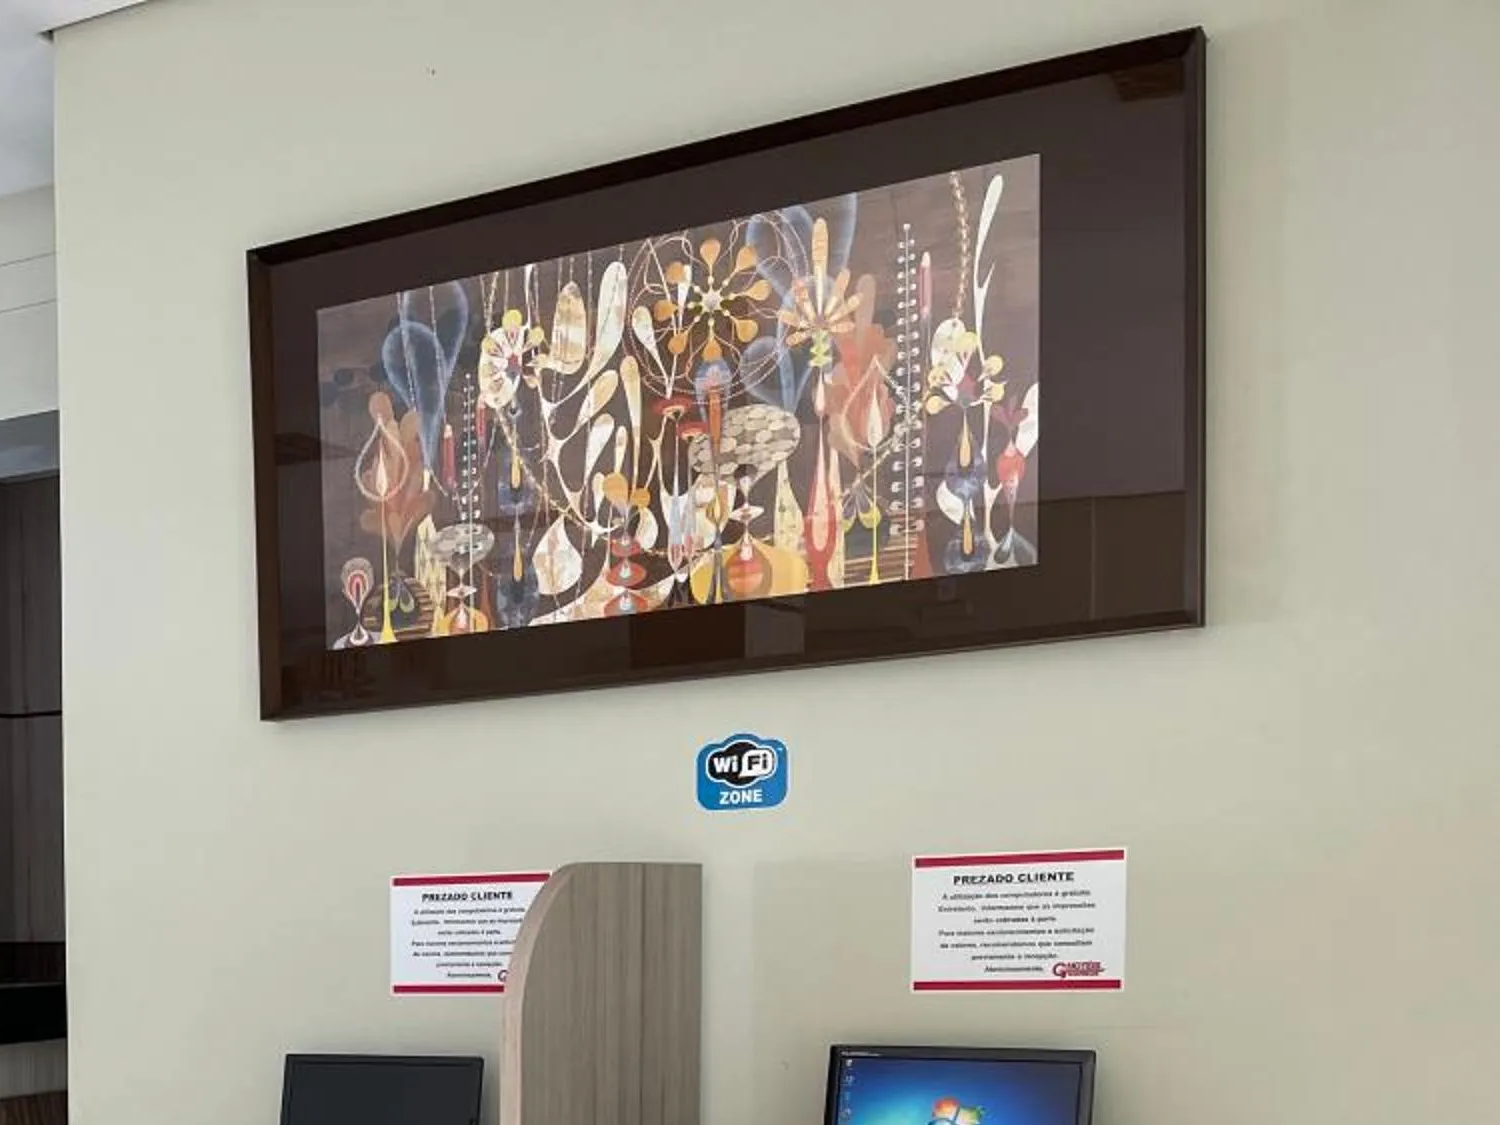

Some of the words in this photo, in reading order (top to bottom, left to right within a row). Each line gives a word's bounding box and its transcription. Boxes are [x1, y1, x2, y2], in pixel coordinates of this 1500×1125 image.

[719, 789, 763, 804] ZONE
[953, 873, 1014, 886] PREZADO
[1017, 871, 1075, 883] CLIENTE
[421, 892, 468, 903] PREZADO
[470, 890, 512, 901] CLIENTE
